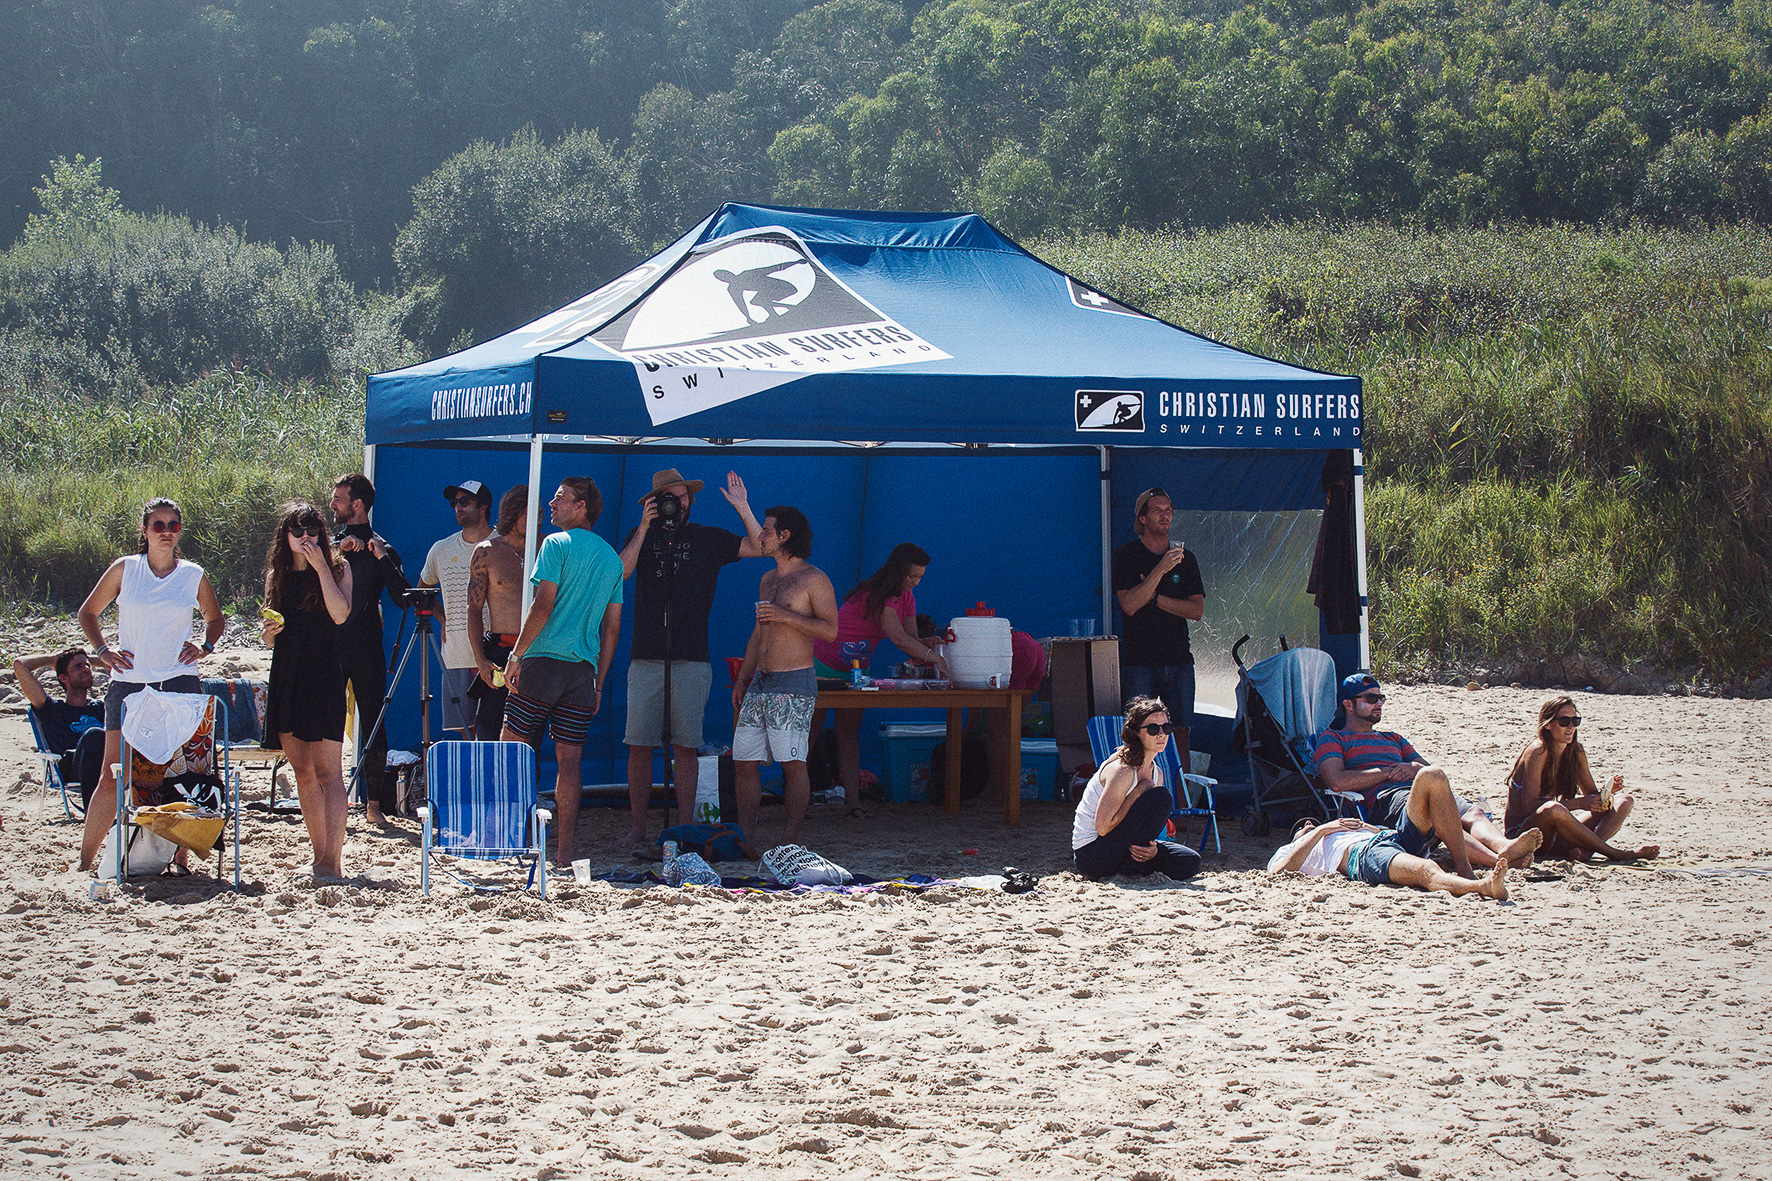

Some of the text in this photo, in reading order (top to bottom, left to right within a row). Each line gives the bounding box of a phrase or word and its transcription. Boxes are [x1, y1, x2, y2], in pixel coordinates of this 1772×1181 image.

[632, 325, 913, 372] CHRISTIAN SURFERS
[652, 345, 931, 399] SWITZERLAND
[431, 382, 532, 420] CHRISTIANSURFERS.CH
[1159, 391, 1360, 419] CHRISTIAN SURFERS
[1159, 423, 1360, 436] SWITZERLAND
